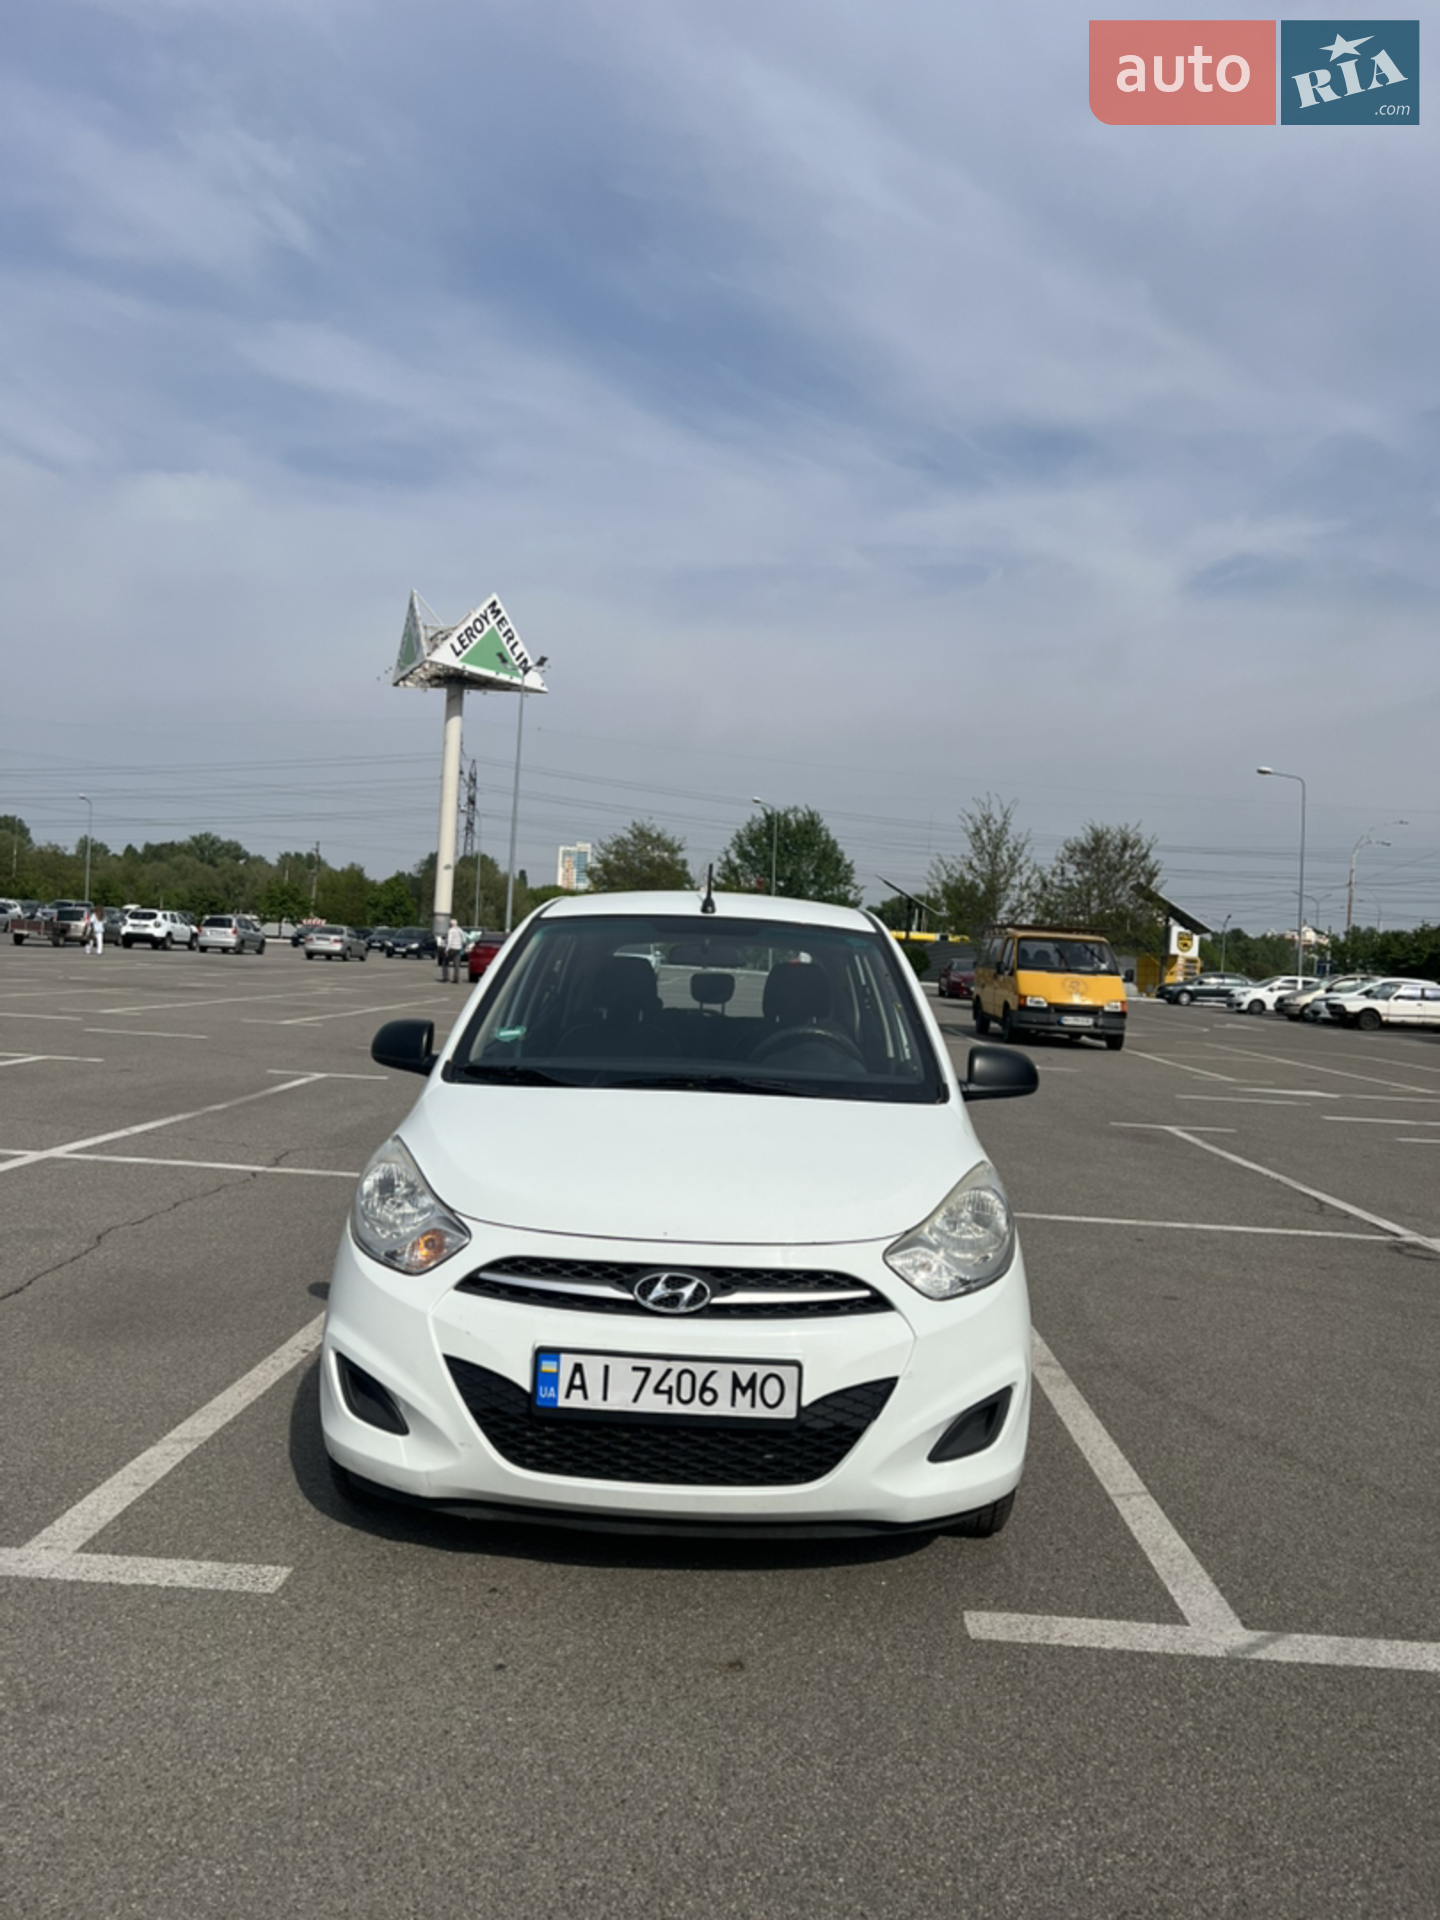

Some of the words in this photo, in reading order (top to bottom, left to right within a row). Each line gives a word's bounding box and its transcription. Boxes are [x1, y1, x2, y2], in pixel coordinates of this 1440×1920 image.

[449, 609, 492, 658] LEROY
[488, 599, 533, 676] MERLIN
[539, 1386, 556, 1399] UA
[564, 1362, 609, 1402] AI
[631, 1366, 718, 1407] 7406
[730, 1370, 786, 1410] MO
